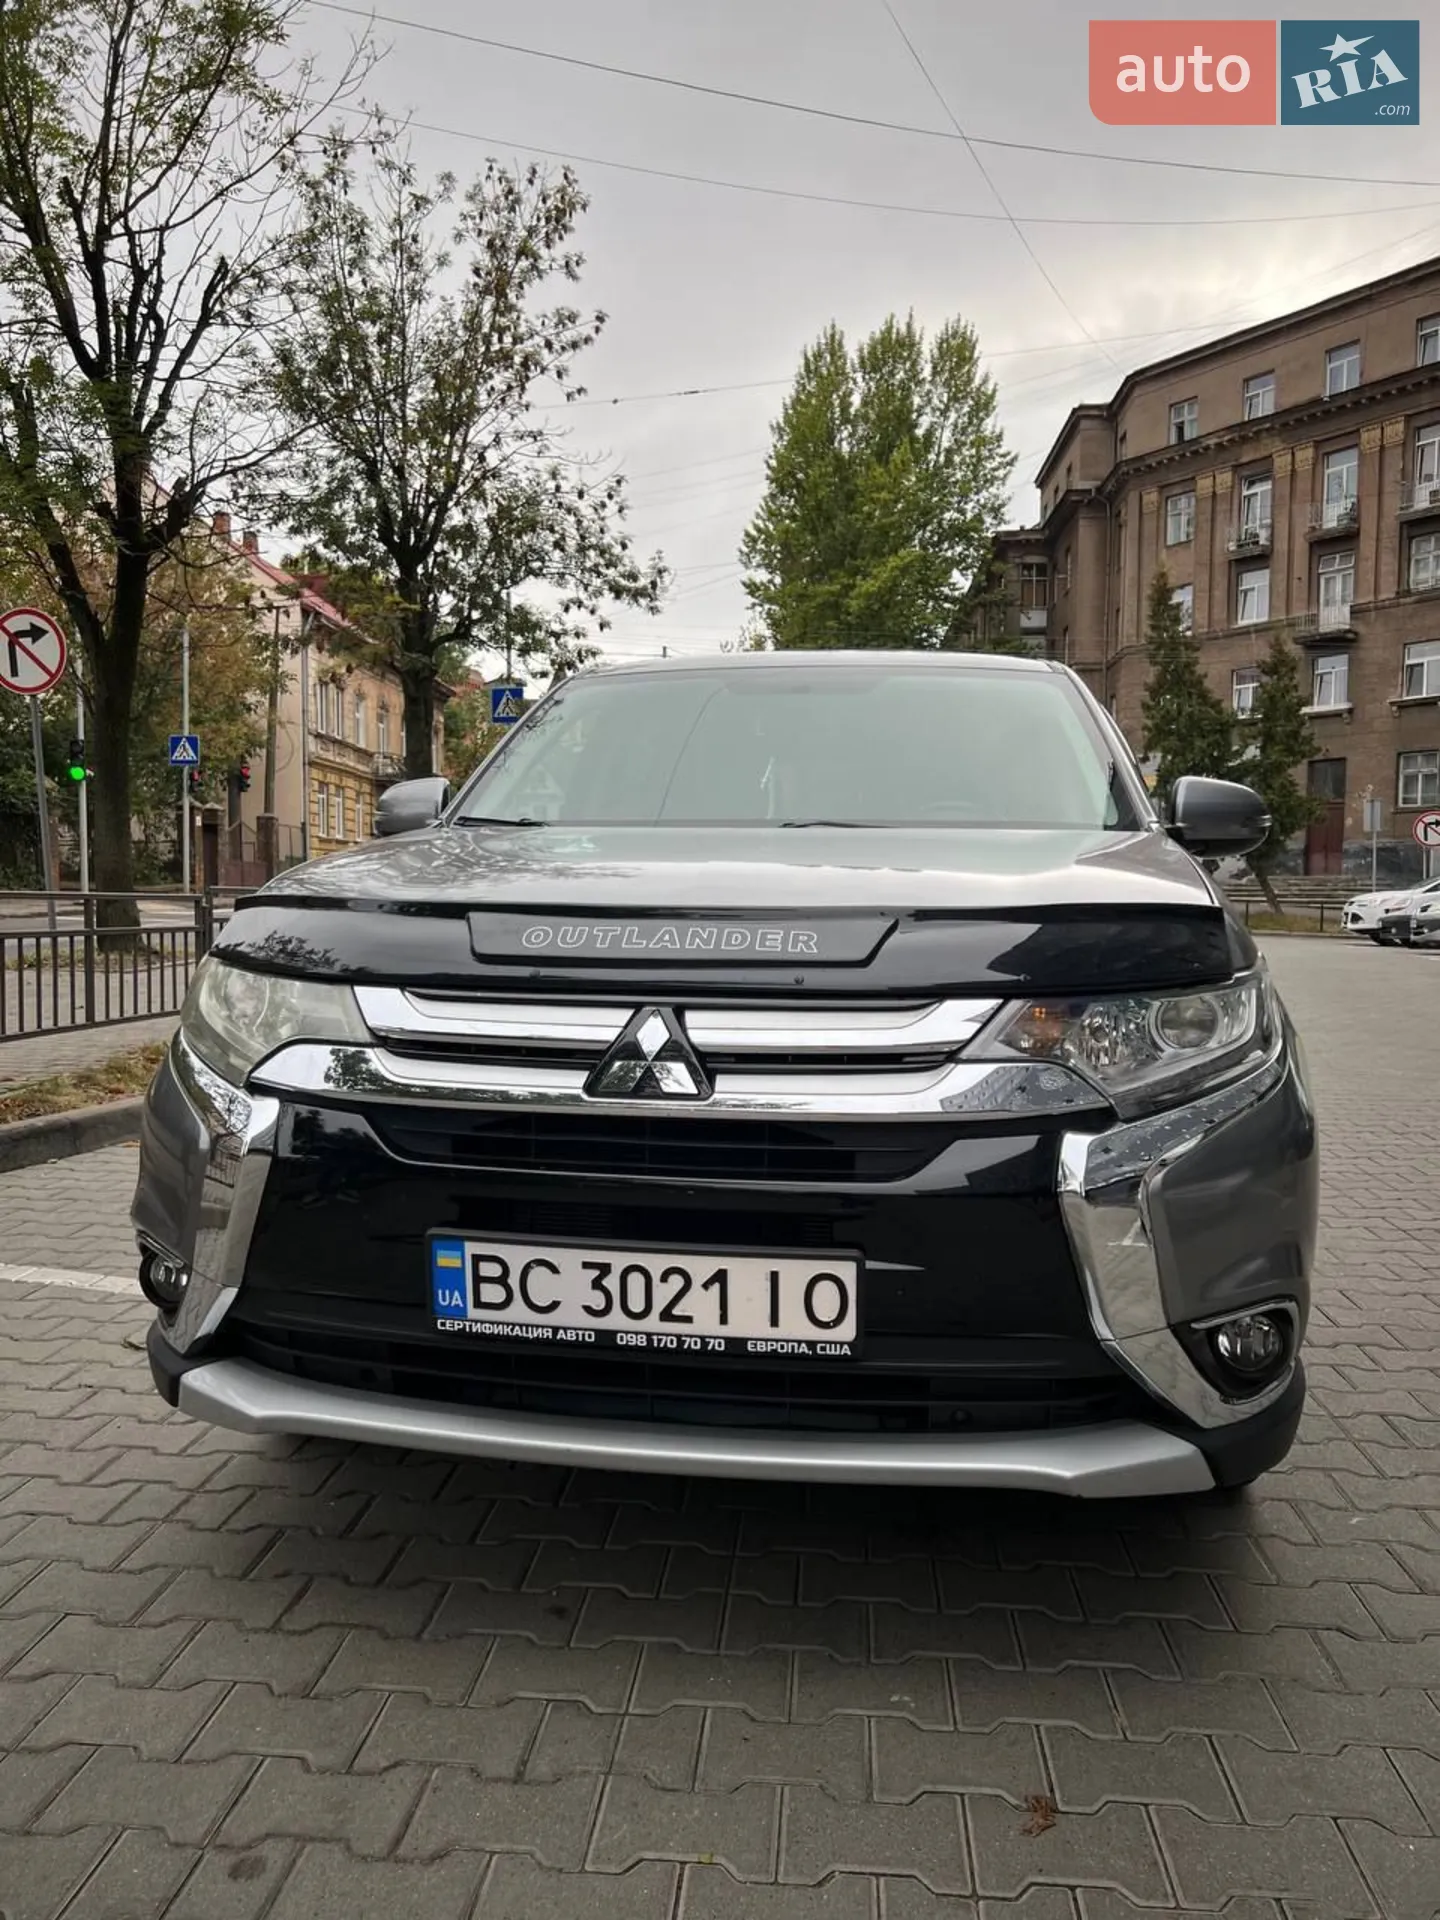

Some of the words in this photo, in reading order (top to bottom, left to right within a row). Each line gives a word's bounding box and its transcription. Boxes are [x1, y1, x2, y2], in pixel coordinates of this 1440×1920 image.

[522, 926, 818, 954] OUTLANDER
[438, 1290, 463, 1308] UA
[471, 1253, 562, 1315] BC
[581, 1261, 728, 1326] 3021
[769, 1270, 849, 1330] IO
[437, 1319, 553, 1340] СЕРТИФИКАЦИЯ
[556, 1328, 595, 1342] АВТО
[617, 1333, 647, 1347] 098
[652, 1334, 678, 1349] 170
[681, 1336, 701, 1350] 70
[705, 1338, 725, 1352] 70
[747, 1340, 812, 1356] ЕВРОПА,
[817, 1343, 852, 1356] США
